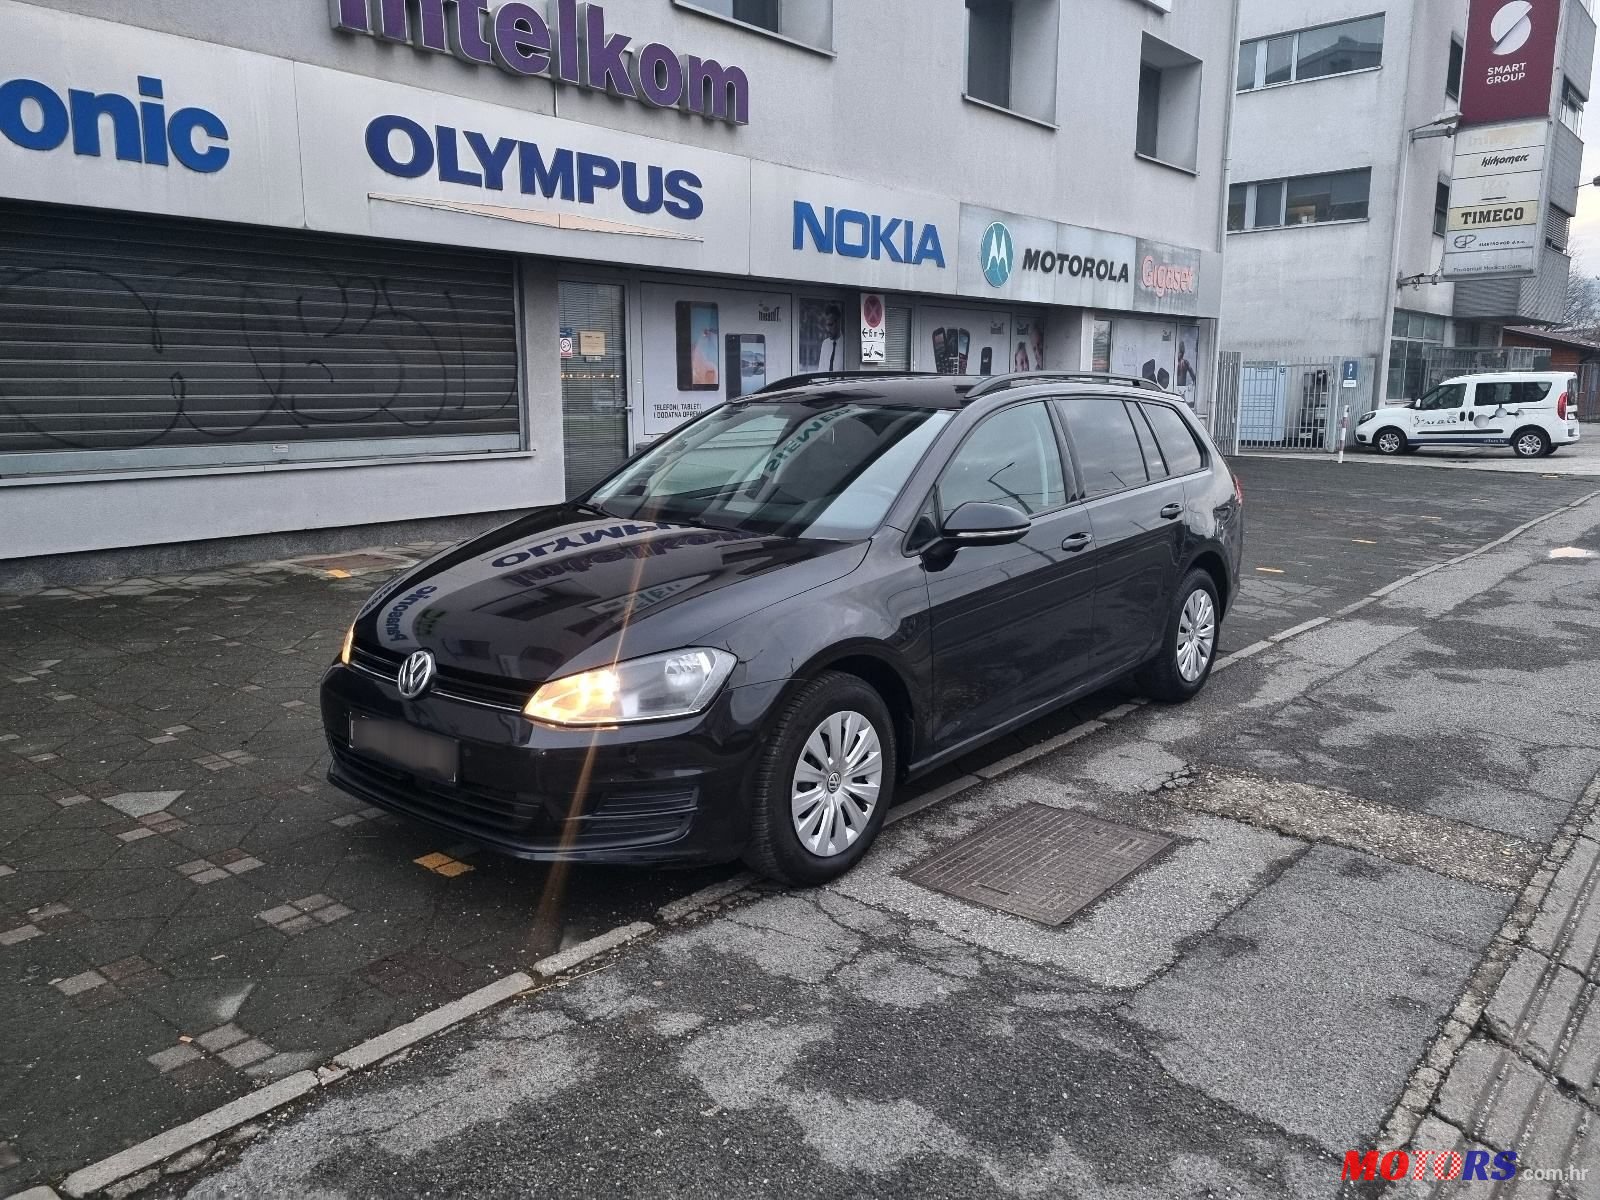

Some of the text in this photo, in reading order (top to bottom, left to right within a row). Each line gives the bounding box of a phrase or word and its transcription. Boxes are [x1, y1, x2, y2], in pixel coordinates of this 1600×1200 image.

[331, 0, 749, 126] ntelkom
[1486, 72, 1526, 85] GROUP
[1487, 62, 1527, 76] SMART
[0, 76, 231, 174] onic
[365, 114, 704, 220] OLYMPUS
[793, 200, 946, 269] NOKIA
[1461, 206, 1524, 225] TIMECO
[1022, 248, 1130, 284] MOTOROLA
[1142, 255, 1193, 298] Gigaset
[682, 410, 704, 418] OPREM
